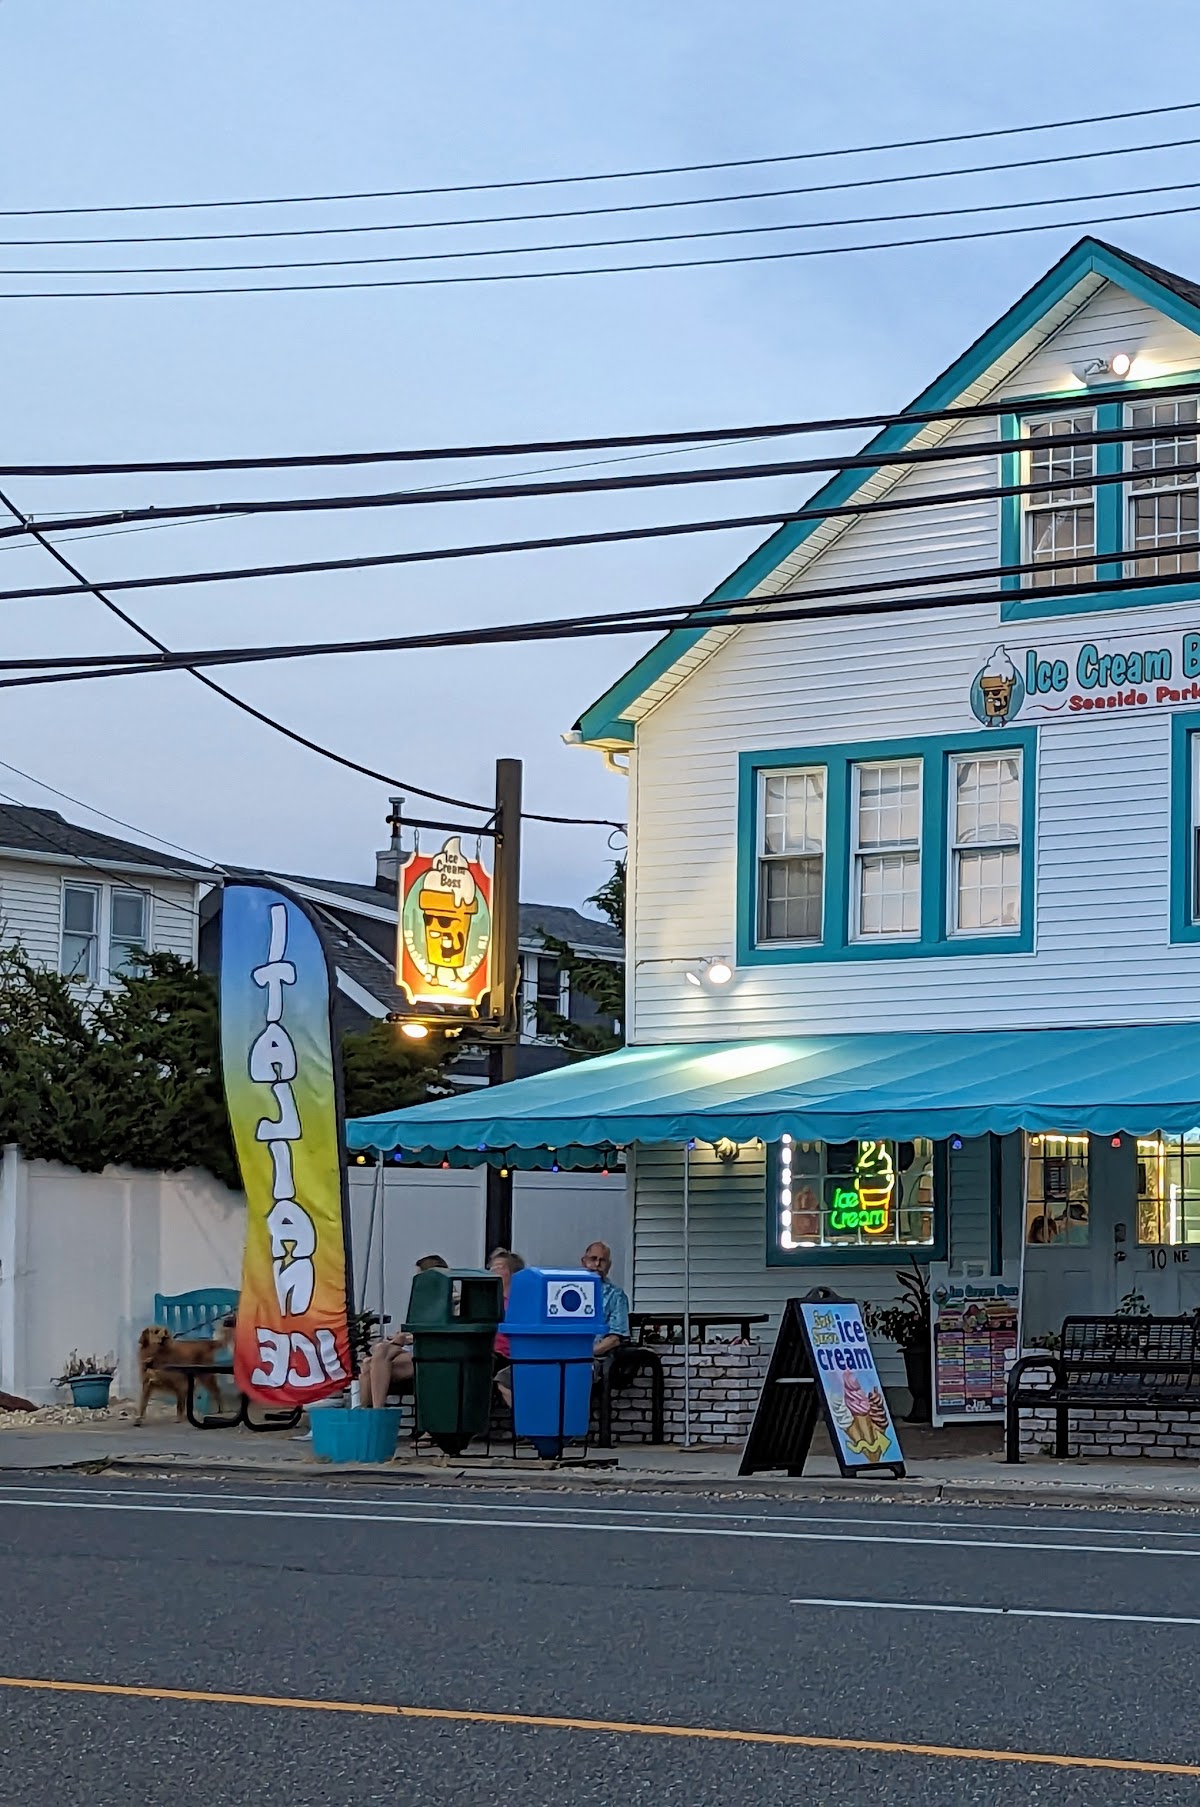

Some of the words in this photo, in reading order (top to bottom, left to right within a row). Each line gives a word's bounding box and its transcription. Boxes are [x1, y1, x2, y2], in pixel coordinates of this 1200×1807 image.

[1025, 649, 1068, 695] Ice
[1076, 644, 1172, 689] Cream
[1068, 689, 1148, 712] Seaside
[445, 850, 459, 864] Ice
[436, 859, 466, 876] Cream
[440, 873, 461, 889] Boss
[833, 1188, 859, 1209] Ice
[831, 1210, 886, 1230] Cream
[1148, 1249, 1167, 1269] 10
[1173, 1249, 1189, 1263] NE
[834, 1313, 866, 1343] ice
[817, 1347, 873, 1371] cream
